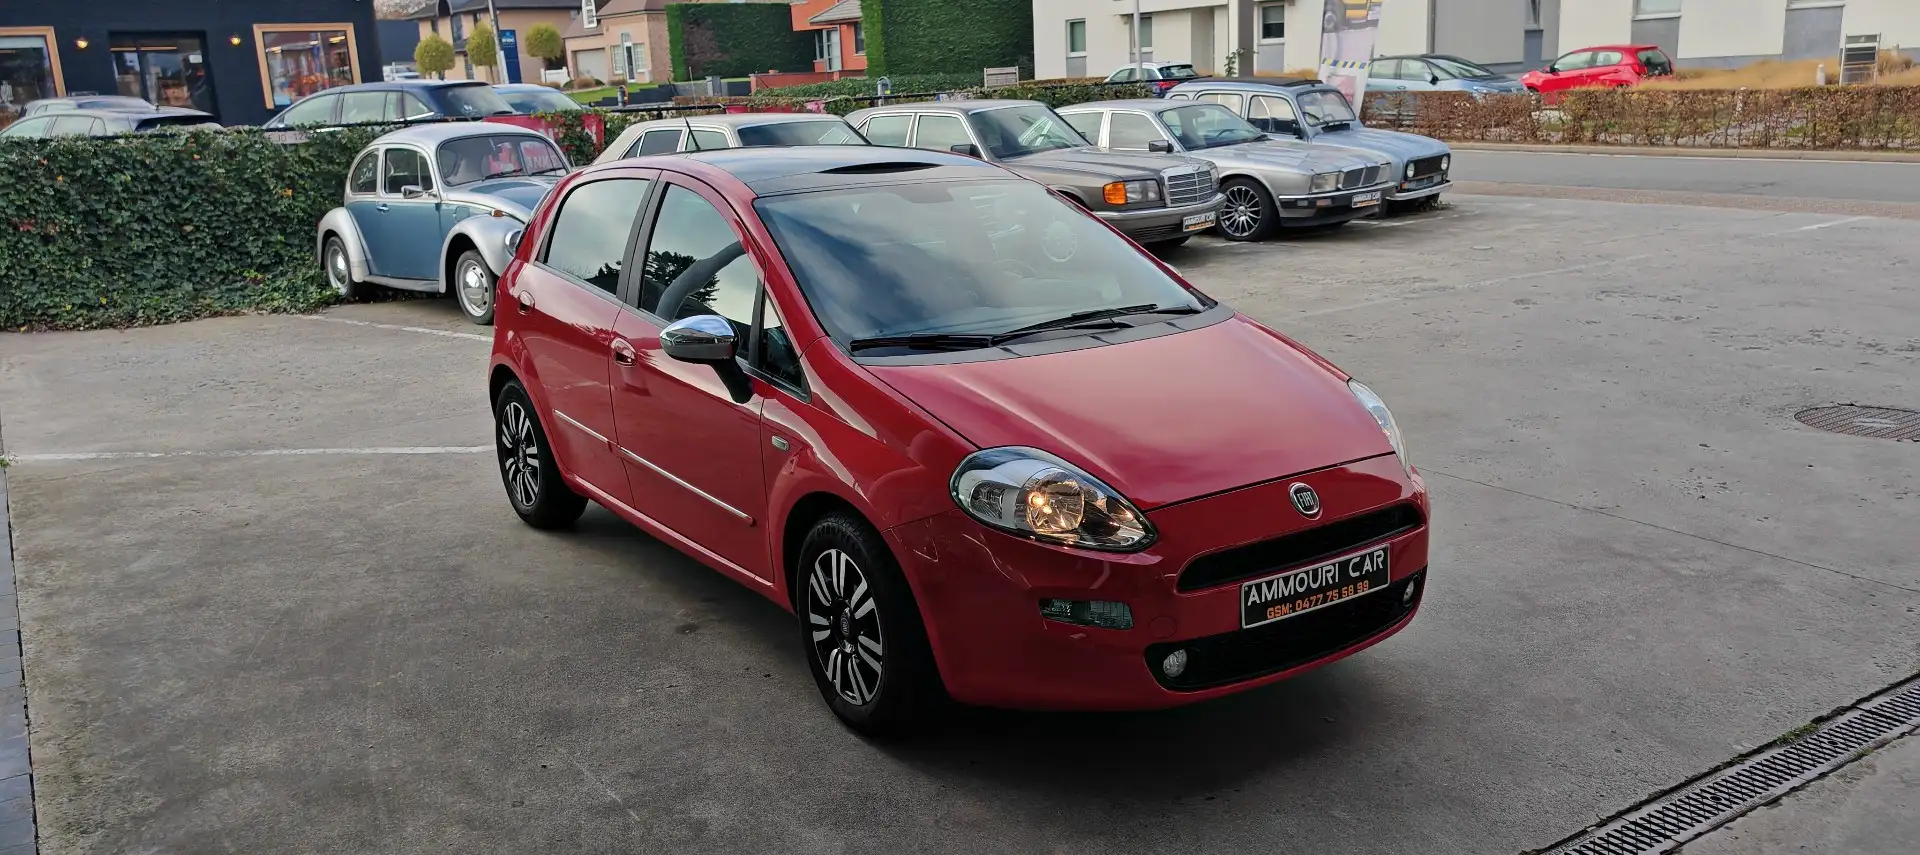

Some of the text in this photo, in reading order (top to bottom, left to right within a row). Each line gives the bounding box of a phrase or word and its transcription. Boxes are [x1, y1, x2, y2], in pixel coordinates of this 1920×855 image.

[1297, 491, 1315, 508] FIAT
[1247, 549, 1385, 606] AMMOURI CAR
[1266, 579, 1370, 620] GSM: 0477 75 58 99
